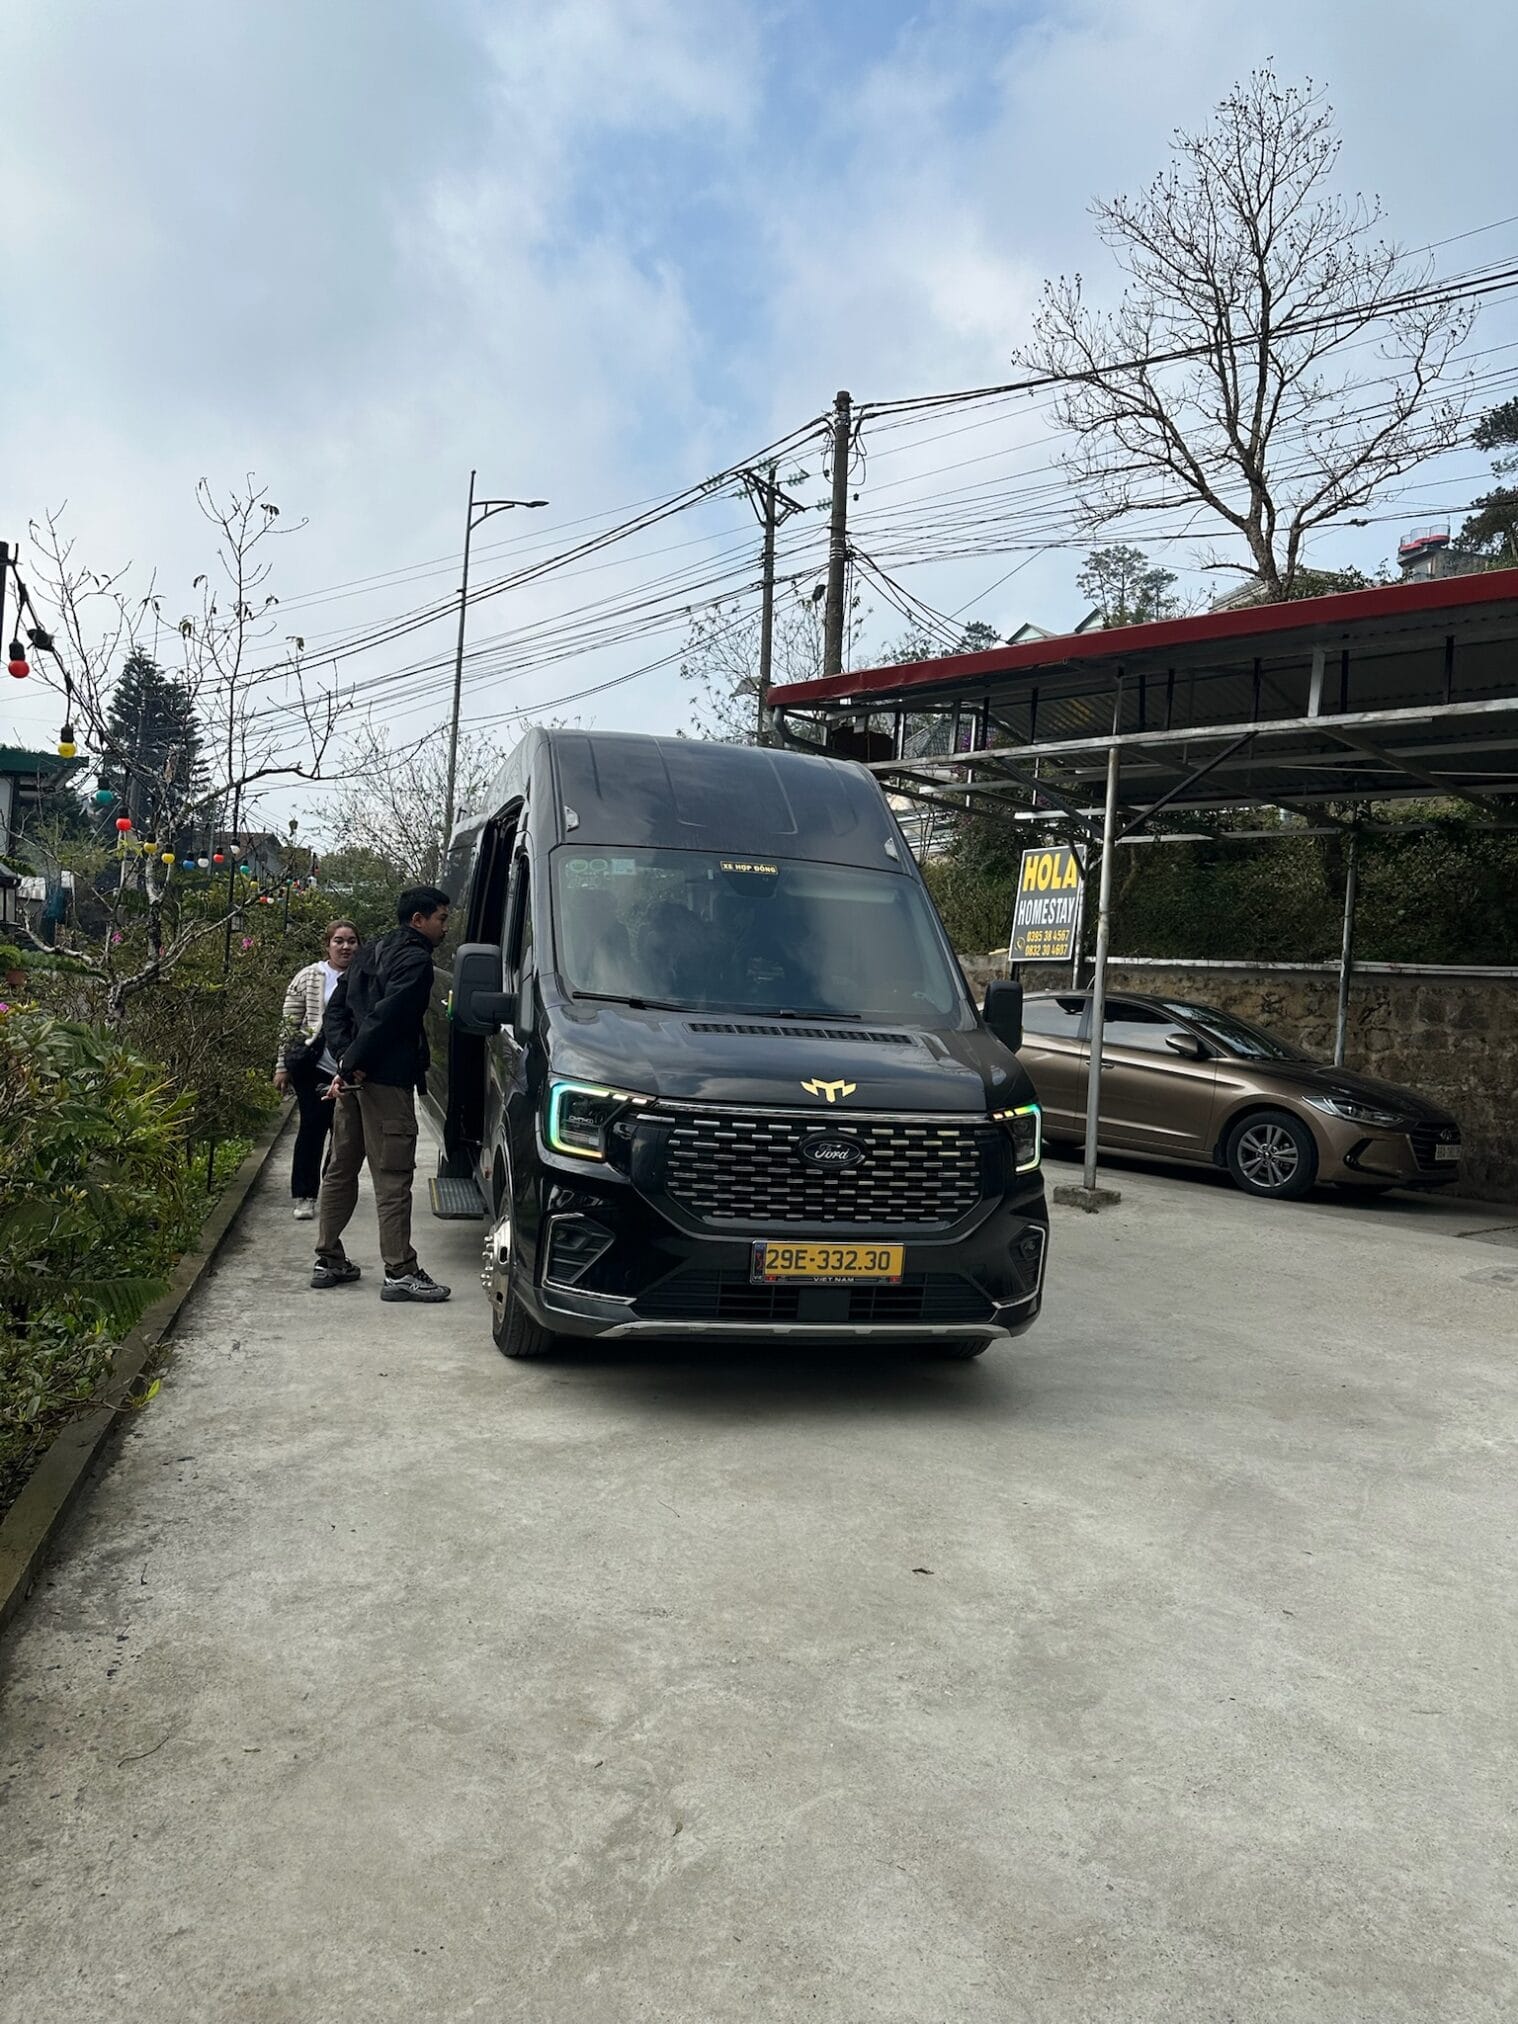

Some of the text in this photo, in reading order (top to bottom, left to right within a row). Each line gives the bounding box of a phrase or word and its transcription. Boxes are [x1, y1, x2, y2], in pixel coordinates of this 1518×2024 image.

[1022, 853, 1078, 892] HOLA
[1017, 897, 1075, 926] HOMESTAY
[1053, 929, 1070, 942] 4567
[814, 1143, 850, 1160] Ford
[766, 1249, 891, 1271] 29E-332.30
